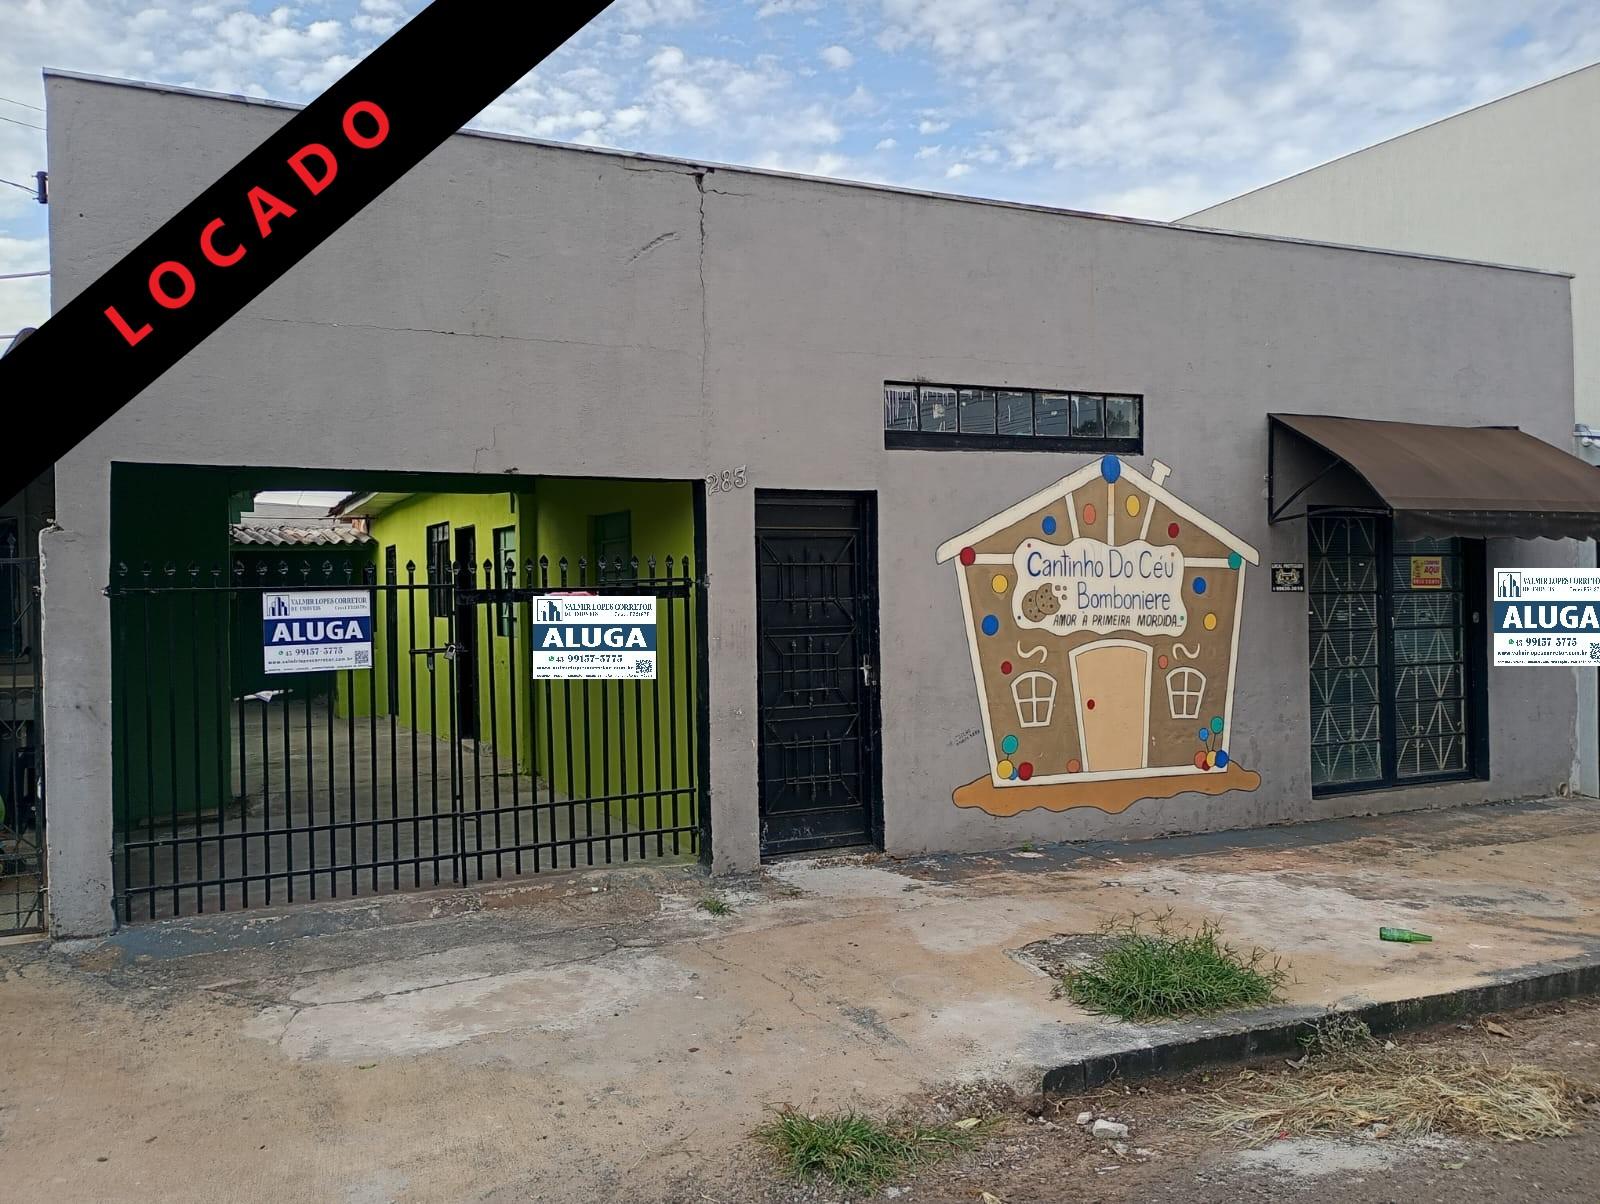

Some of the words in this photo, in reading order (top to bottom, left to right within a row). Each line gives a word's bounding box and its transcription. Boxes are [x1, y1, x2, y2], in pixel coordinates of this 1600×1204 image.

[1027, 549, 1104, 578] Cantinho
[1109, 549, 1134, 578] Do
[1139, 550, 1174, 578] Céu
[1077, 581, 1170, 611] Bomboniere
[271, 620, 363, 642] ALUGA
[1053, 614, 1077, 627] AMOR
[1092, 614, 1131, 627] PRIMEIRA
